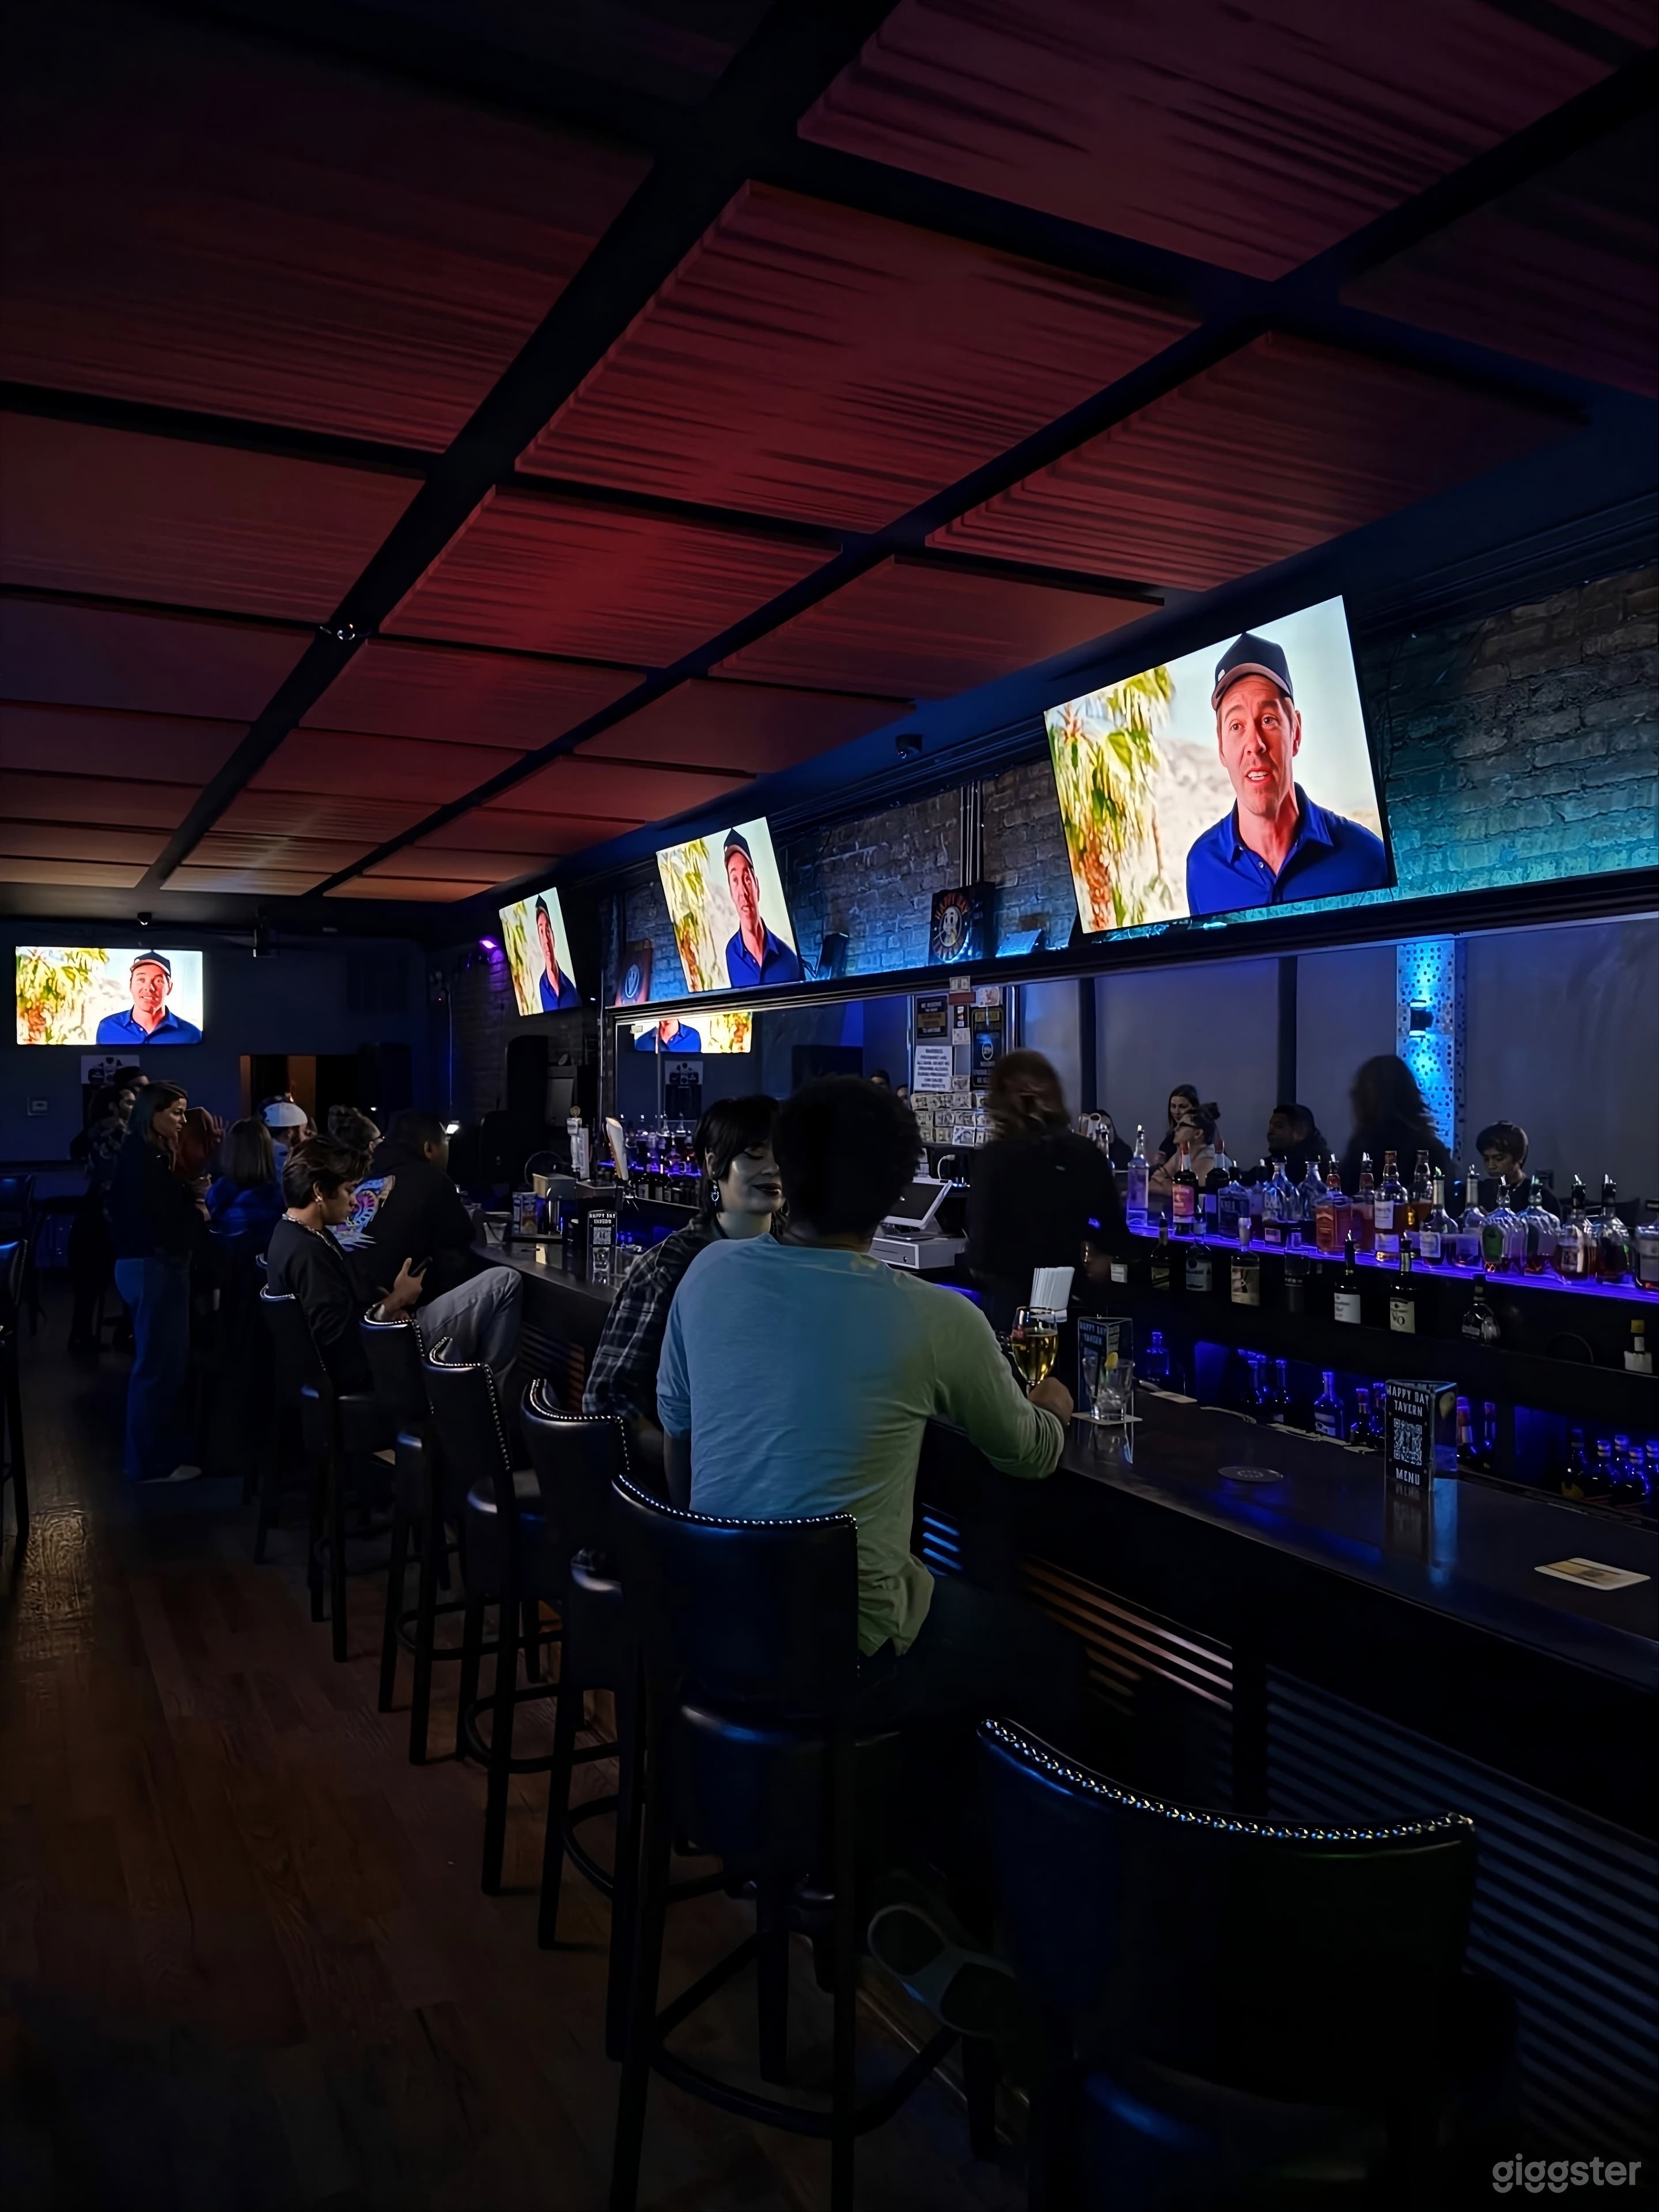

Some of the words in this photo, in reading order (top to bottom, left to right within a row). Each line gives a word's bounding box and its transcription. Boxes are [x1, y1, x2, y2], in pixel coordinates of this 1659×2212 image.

[1387, 1385, 1411, 1401] HAPPY
[1394, 1400, 1422, 1417] TAVERN
[1396, 1467, 1420, 1486] MENU
